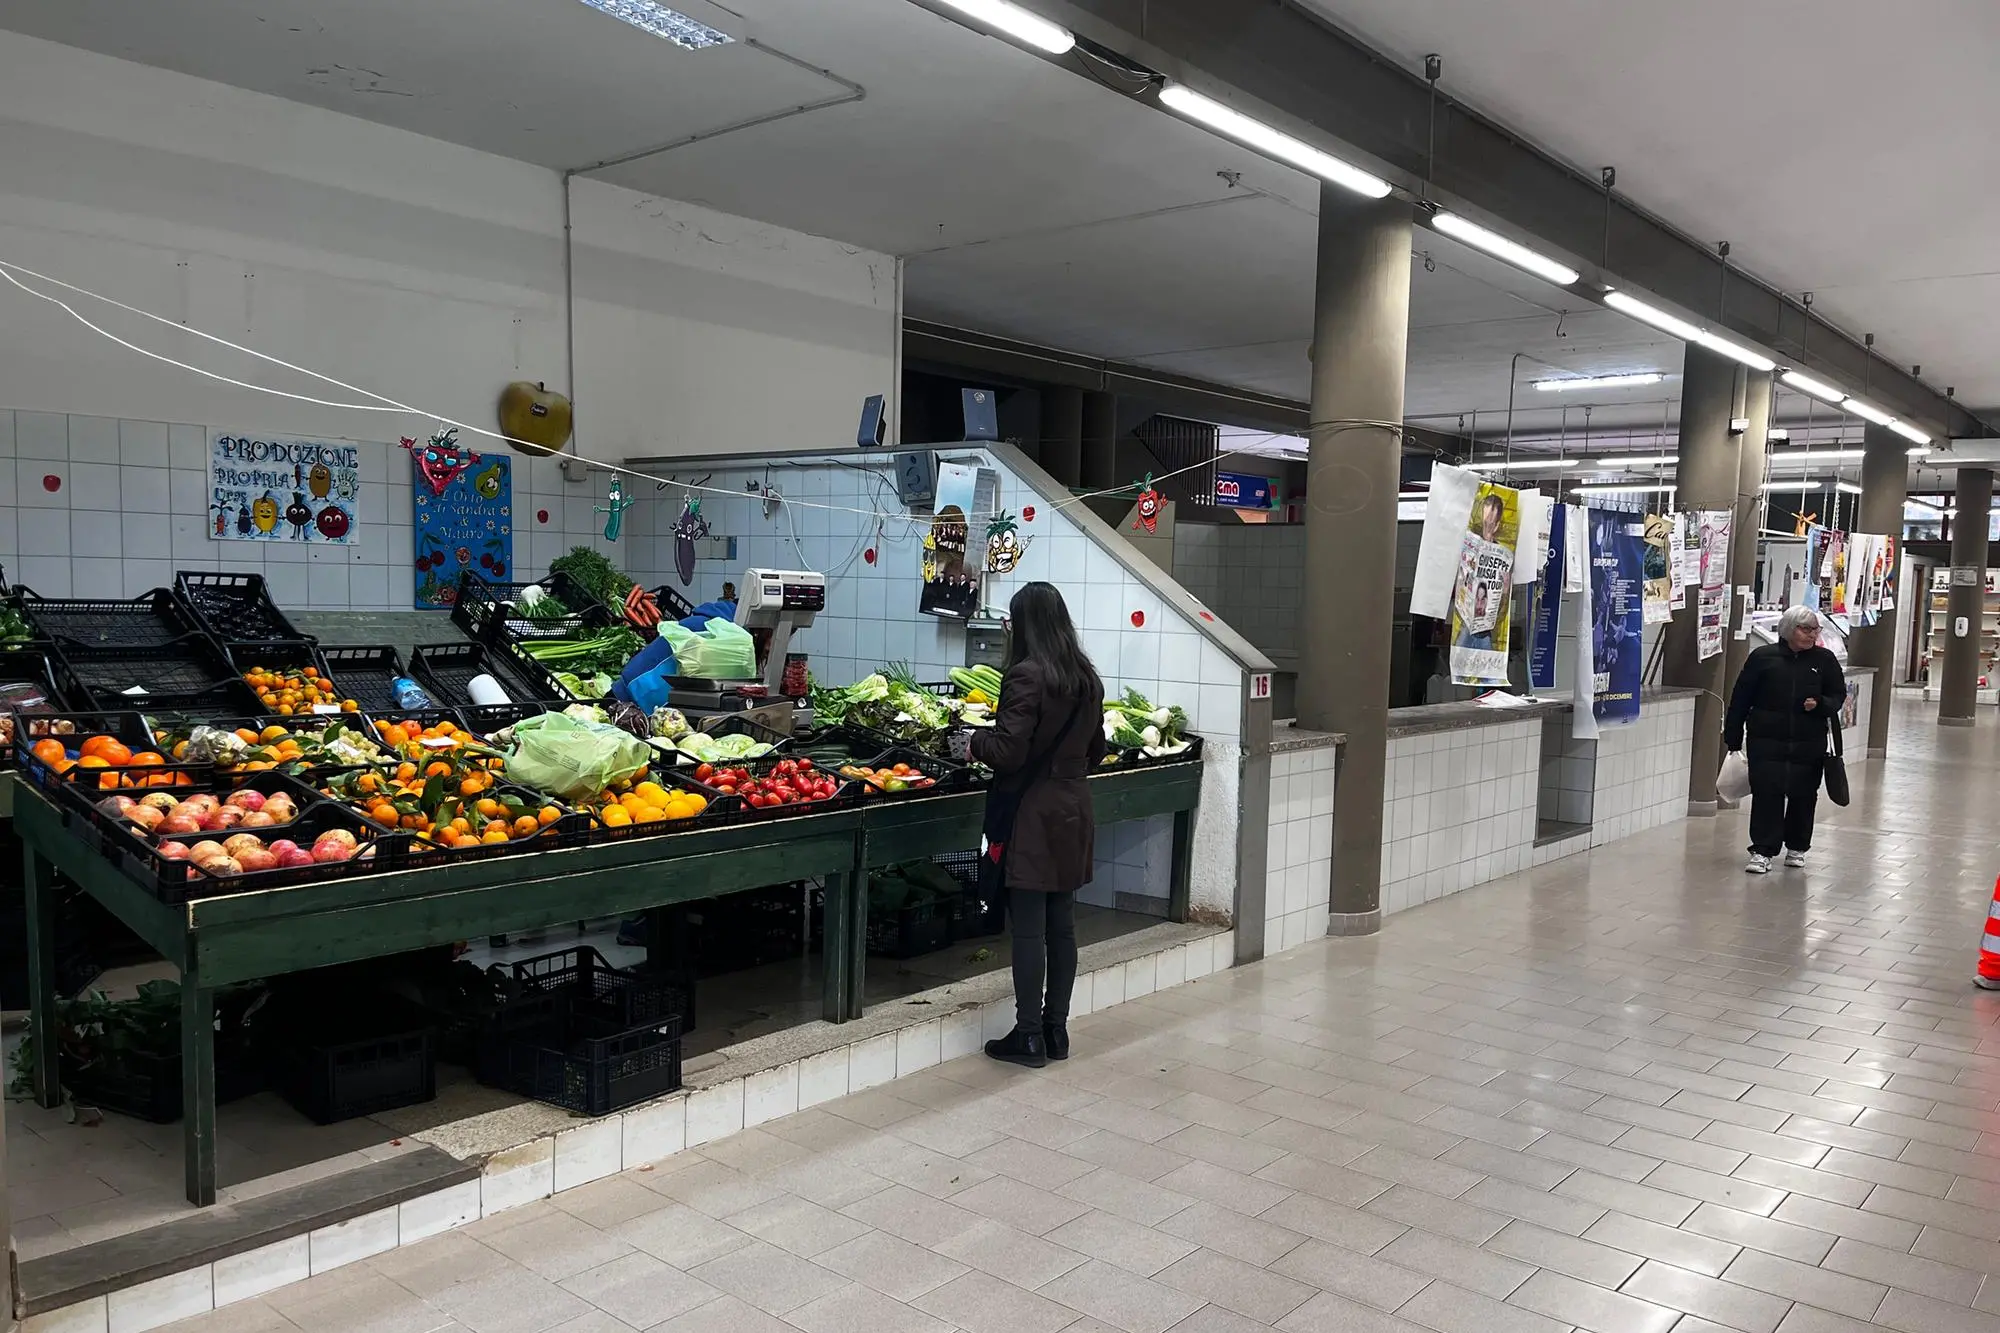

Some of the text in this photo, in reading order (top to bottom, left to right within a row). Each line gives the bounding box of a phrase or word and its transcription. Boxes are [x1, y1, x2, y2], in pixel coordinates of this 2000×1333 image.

[220, 436, 359, 469] PRODUZIONE
[214, 467, 291, 490] PROPRIA
[450, 502, 496, 516] Sandra
[460, 516, 469, 527] &
[439, 526, 484, 539] Mauro
[1476, 566, 1497, 580] MASIA
[1255, 675, 1268, 697] 16
